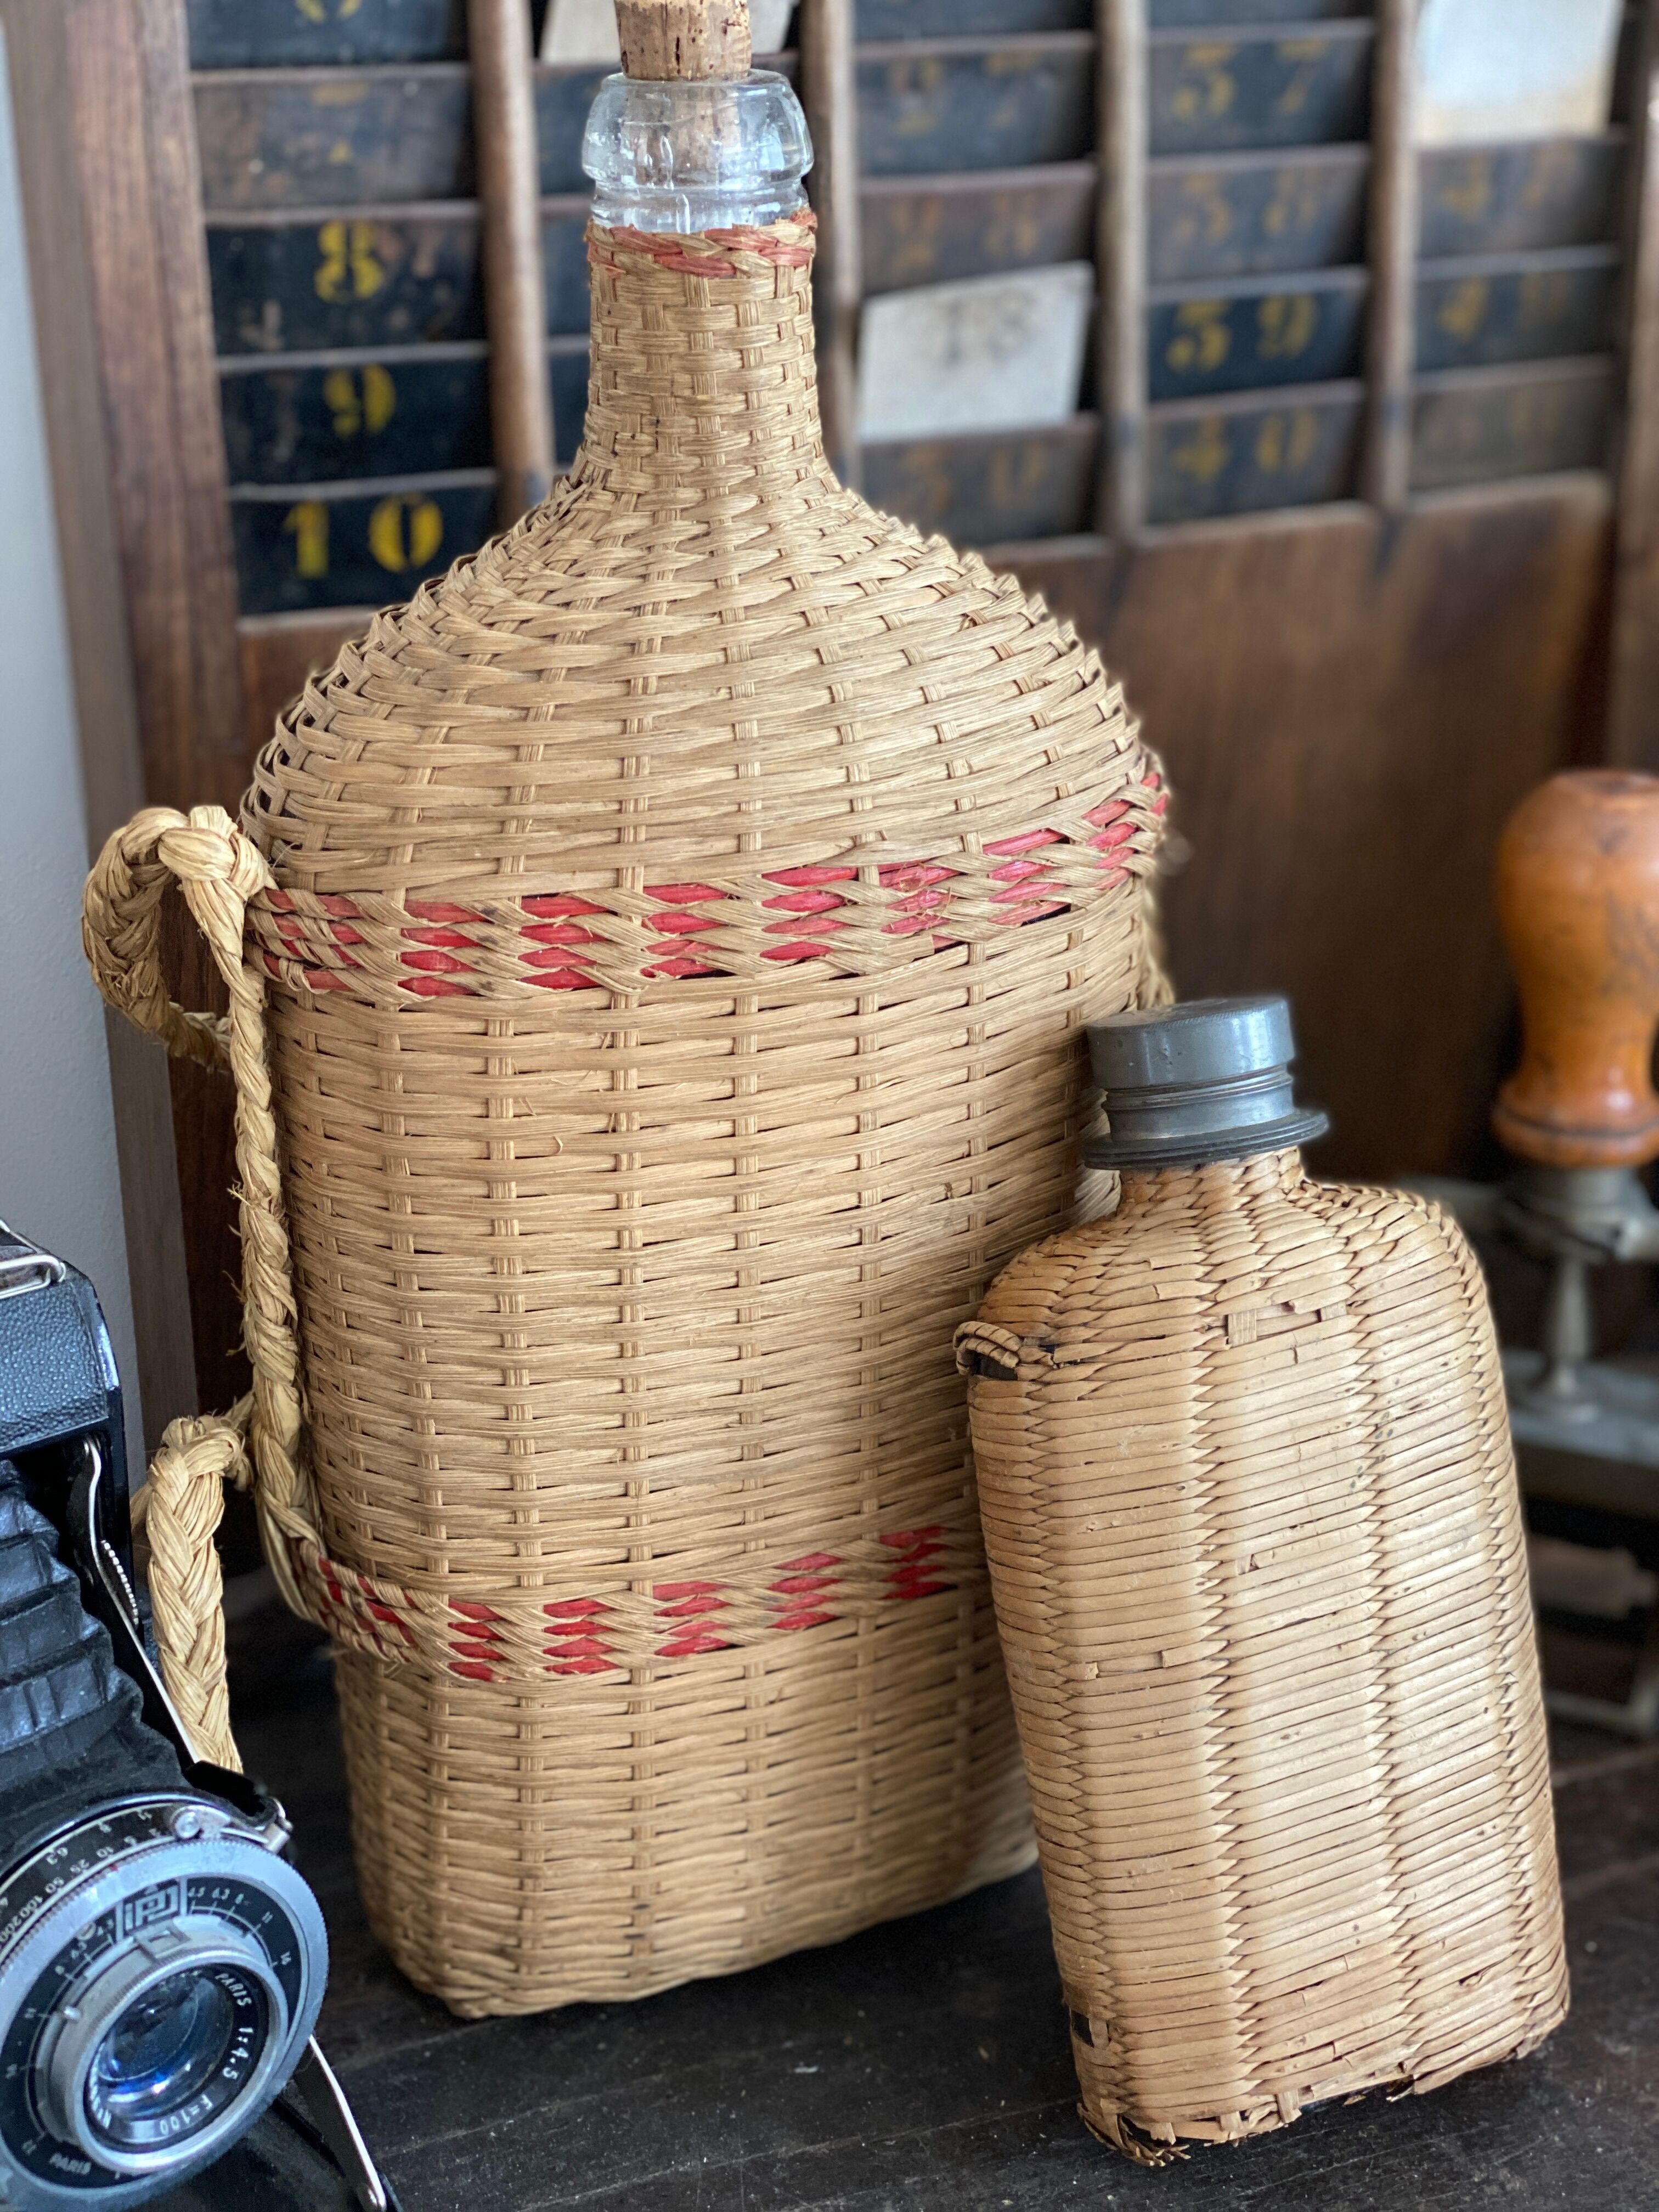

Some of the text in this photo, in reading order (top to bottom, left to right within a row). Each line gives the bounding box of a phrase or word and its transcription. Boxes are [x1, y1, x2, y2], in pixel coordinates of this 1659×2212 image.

[315, 219, 384, 302] 8
[323, 363, 396, 435] 9
[284, 493, 443, 579] 10
[20, 1895, 43, 1918] 100
[44, 1876, 65, 1893] 50
[95, 1846, 114, 1858] 10
[215, 1973, 252, 2006] PARIS
[222, 2027, 254, 2080] 1:4.5
[159, 2094, 214, 2135] F=100
